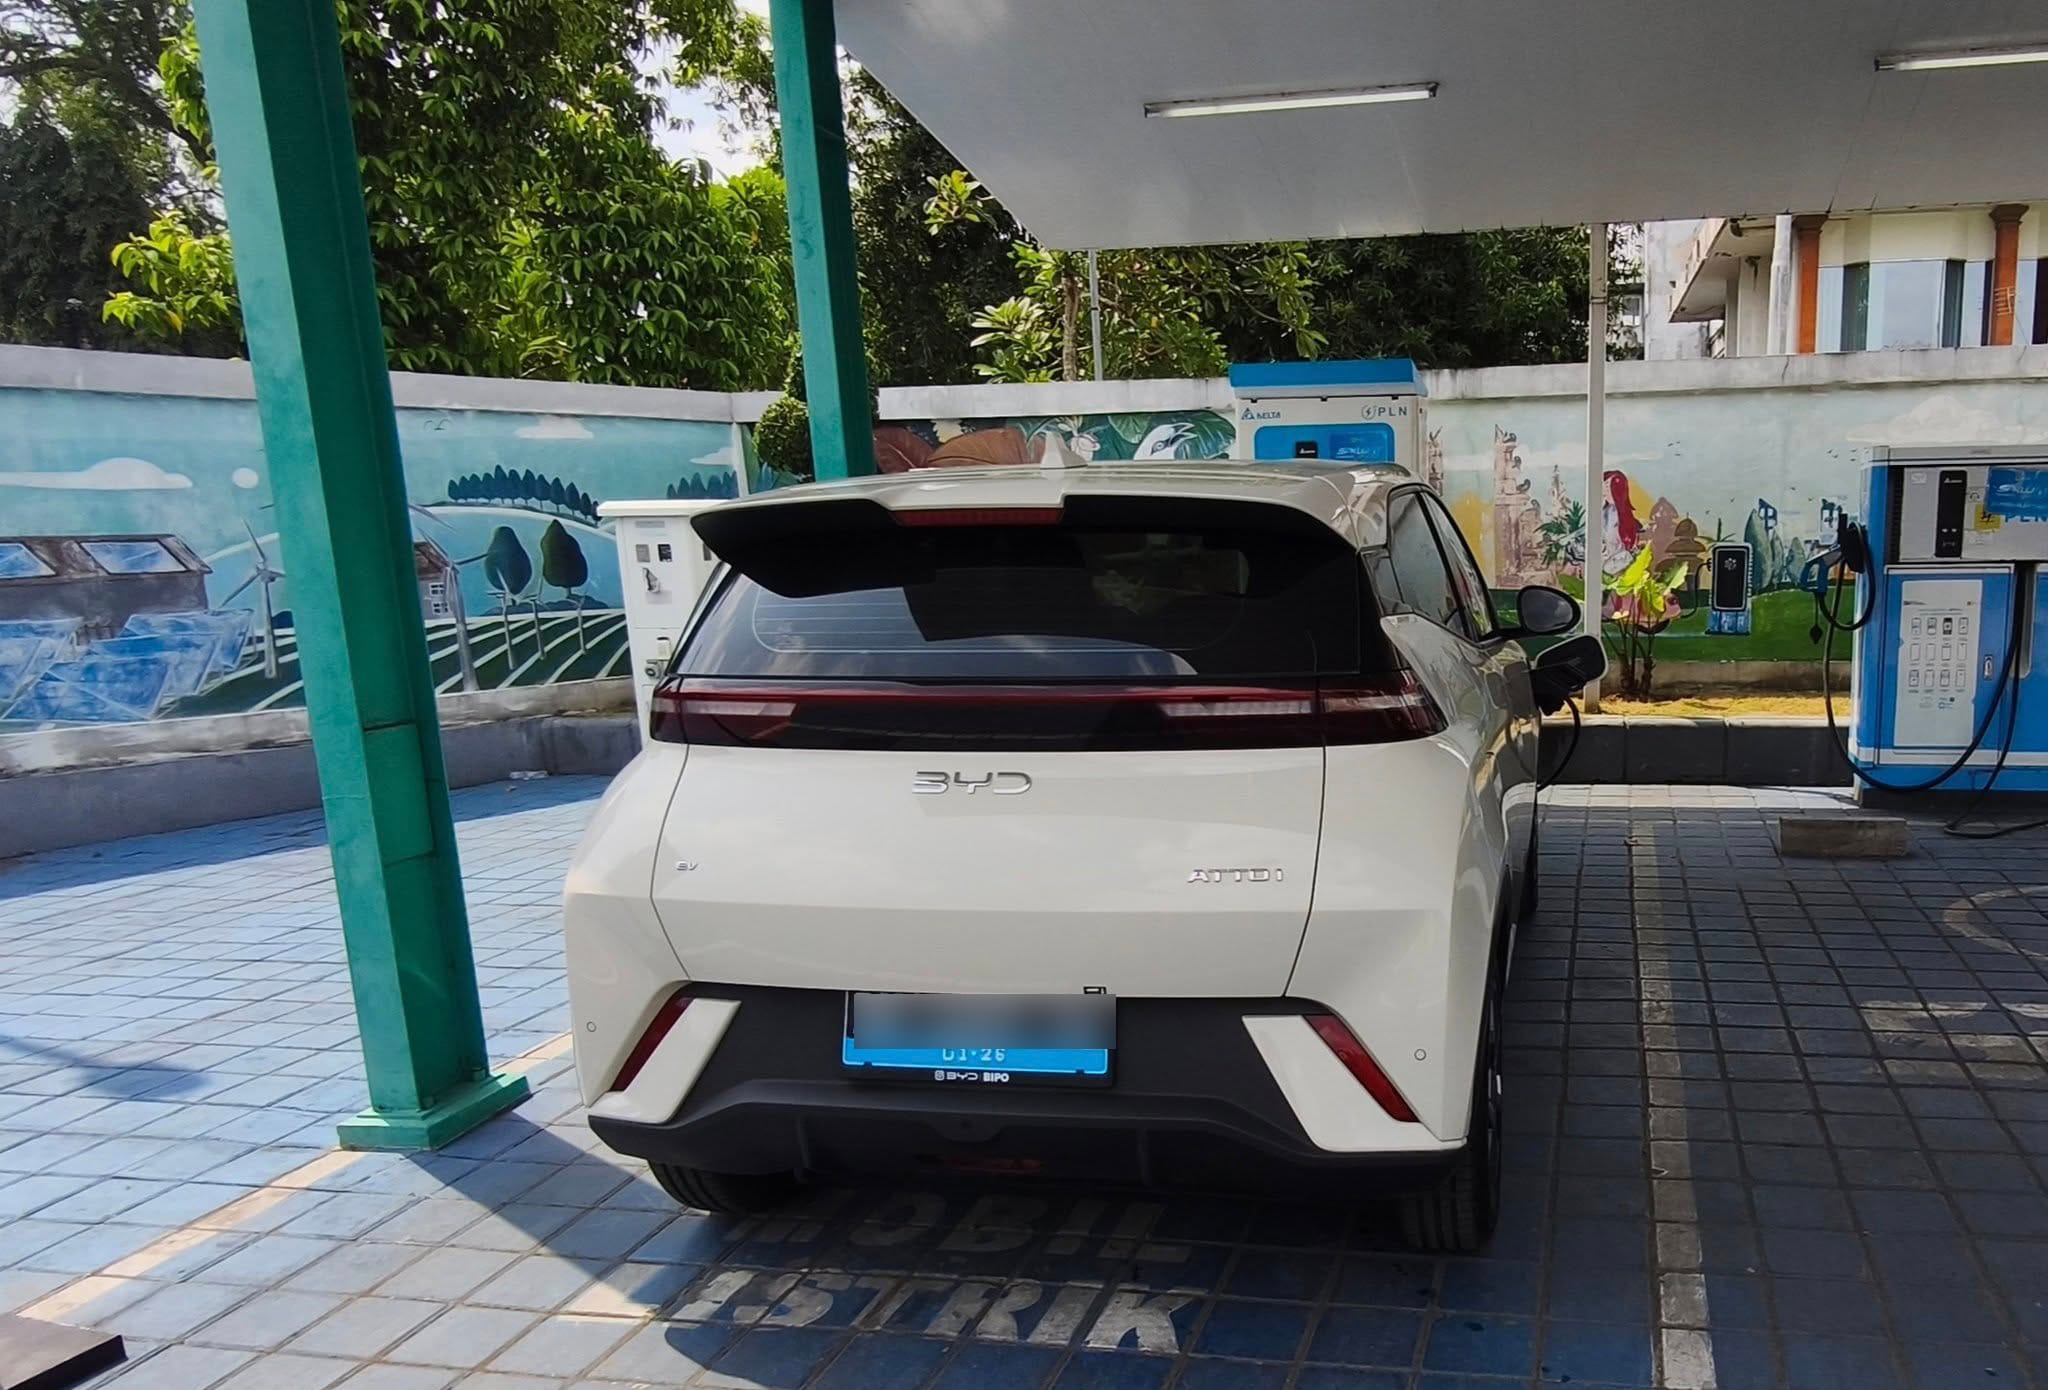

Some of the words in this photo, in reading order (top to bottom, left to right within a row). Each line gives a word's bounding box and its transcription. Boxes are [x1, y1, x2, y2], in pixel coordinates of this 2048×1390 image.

[1257, 411, 1281, 419] DELTA
[1378, 406, 1407, 417] PLN
[912, 771, 1032, 795] BYD
[983, 1072, 1010, 1082] BIPO
